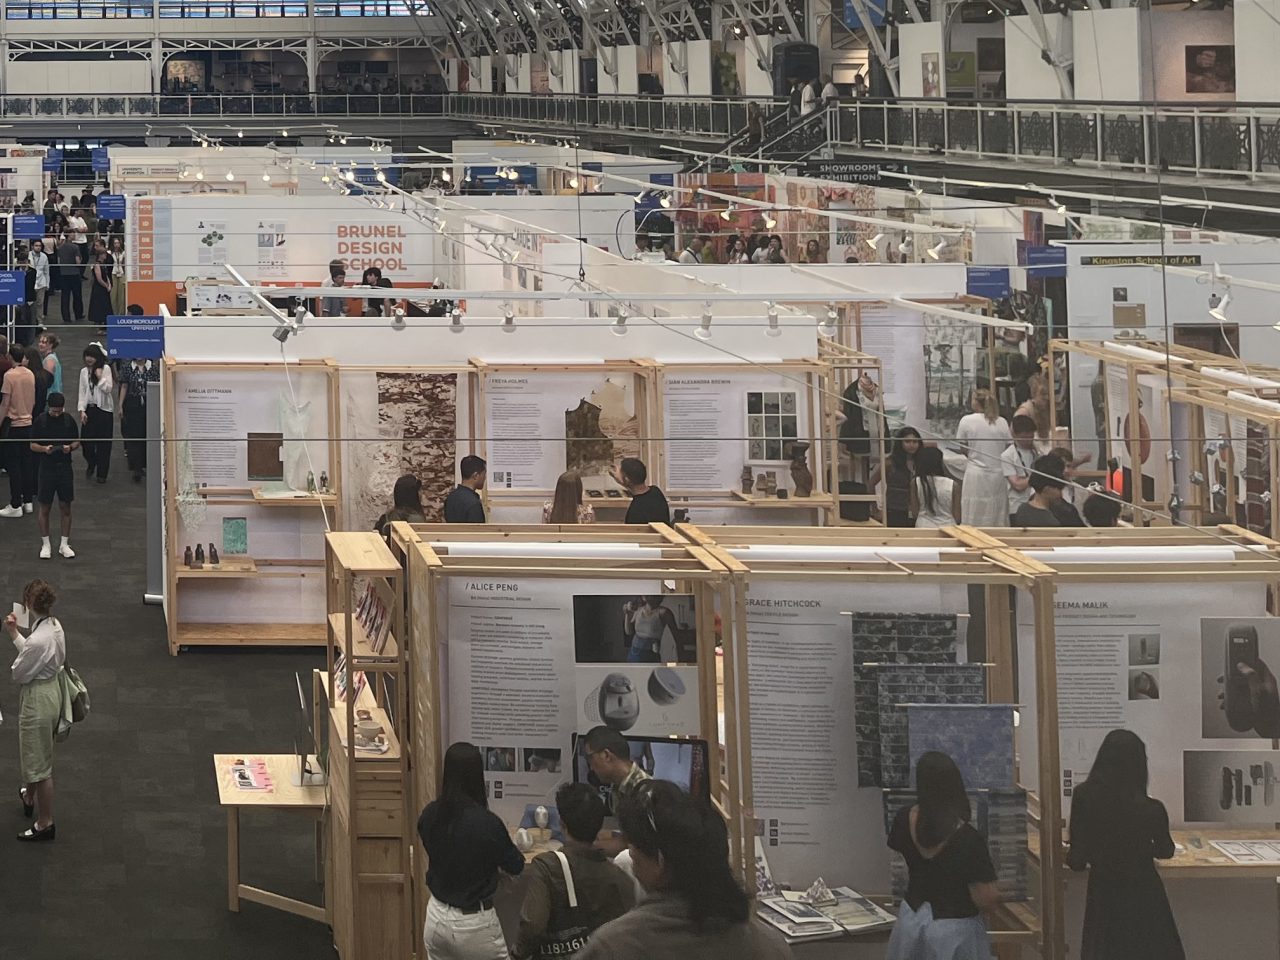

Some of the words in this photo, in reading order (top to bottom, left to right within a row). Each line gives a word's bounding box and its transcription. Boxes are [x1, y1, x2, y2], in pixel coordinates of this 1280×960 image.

[820, 164, 881, 172] SHOWROOMS
[337, 226, 406, 238] BRUNEL
[337, 242, 403, 254] DESIGN
[338, 258, 407, 270] SCHOOL
[1092, 257, 1134, 265] Kingston
[1136, 256, 1168, 264] School
[540, 936, 590, 954] 1182161
